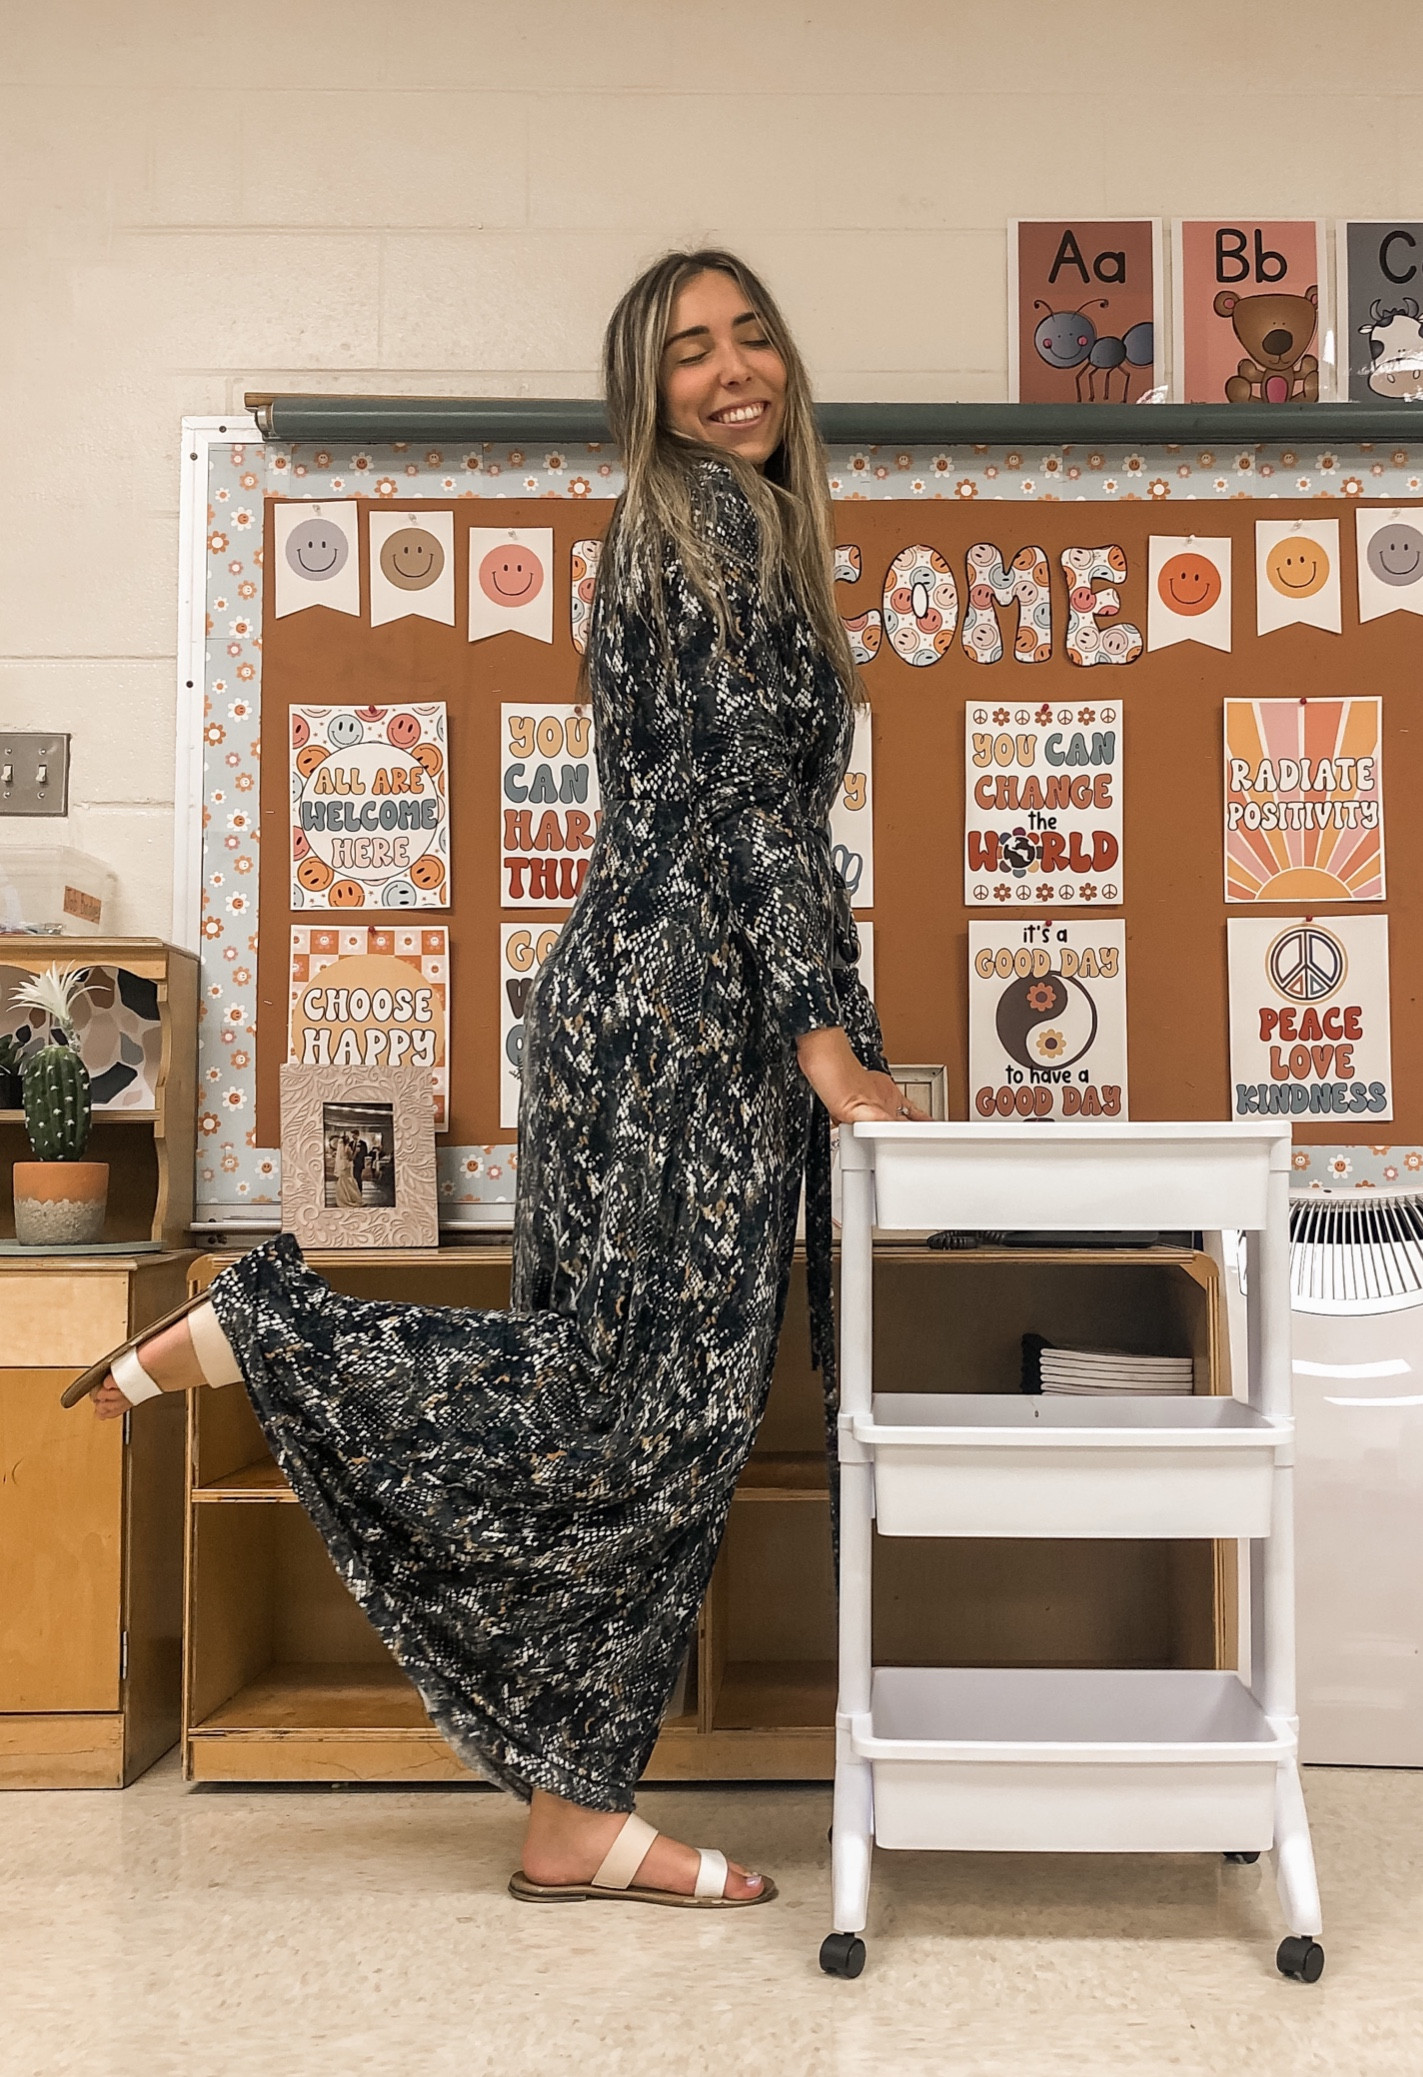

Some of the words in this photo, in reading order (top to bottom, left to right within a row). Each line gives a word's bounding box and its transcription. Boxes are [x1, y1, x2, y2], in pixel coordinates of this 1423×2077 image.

[1048, 229, 1126, 284] Aa
[1215, 228, 1288, 284] Bb
[1379, 230, 1423, 284] C
[508, 716, 592, 759] YOU
[972, 733, 1038, 768] YOU
[1044, 731, 1116, 767] CAN
[314, 767, 366, 795] ALL
[371, 767, 424, 794] ARE
[504, 763, 590, 804] CAN
[974, 773, 1113, 810] CHANGE
[1229, 757, 1375, 792] RADIATE
[302, 798, 438, 832] WELCOME
[1028, 811, 1057, 830] the
[1227, 800, 1380, 831] POSITIVITY
[331, 836, 410, 868] HERE
[1023, 925, 1050, 943] it's
[1056, 928, 1068, 943] a
[975, 948, 1052, 979] GOOD
[1060, 947, 1119, 978] DAY
[303, 988, 433, 1022] CHOOSE
[1259, 1006, 1363, 1042] PEACE
[302, 1027, 437, 1067] HAPPY
[1269, 1043, 1355, 1081] LOVE
[1005, 1065, 1024, 1084] to
[1030, 1065, 1071, 1084] have
[1078, 1069, 1089, 1083] a
[975, 1086, 1053, 1117] GOOD
[1062, 1085, 1121, 1116] DAY
[1236, 1081, 1388, 1115] KINDNESS
